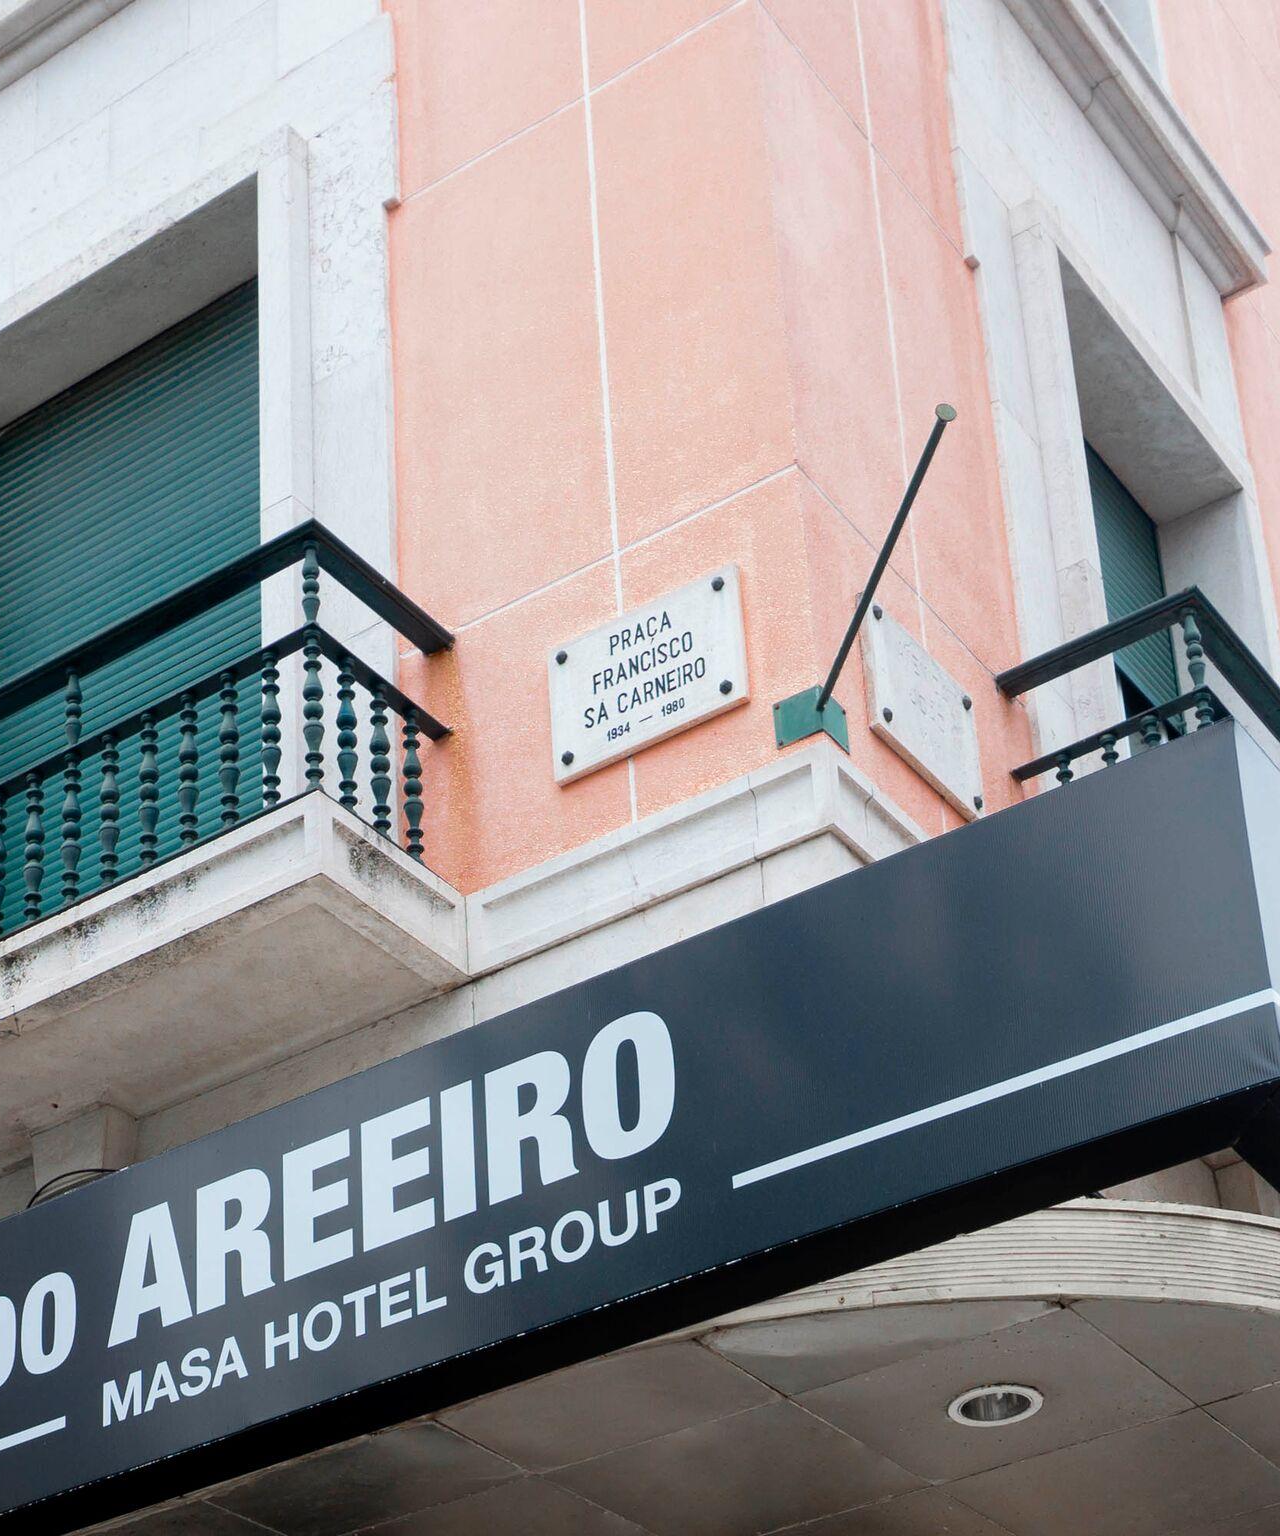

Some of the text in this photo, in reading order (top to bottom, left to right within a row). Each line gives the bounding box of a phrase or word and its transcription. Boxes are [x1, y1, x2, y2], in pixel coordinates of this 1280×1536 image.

[592, 631, 693, 694] FRANCISCO
[609, 610, 672, 655] PRAÇA
[616, 657, 707, 714] CARNEIRO
[606, 721, 631, 742] 1934
[661, 697, 686, 718] 1980
[107, 1010, 677, 1349] AREEIRO
[101, 1176, 682, 1427] MASA HOTEL GROUP
